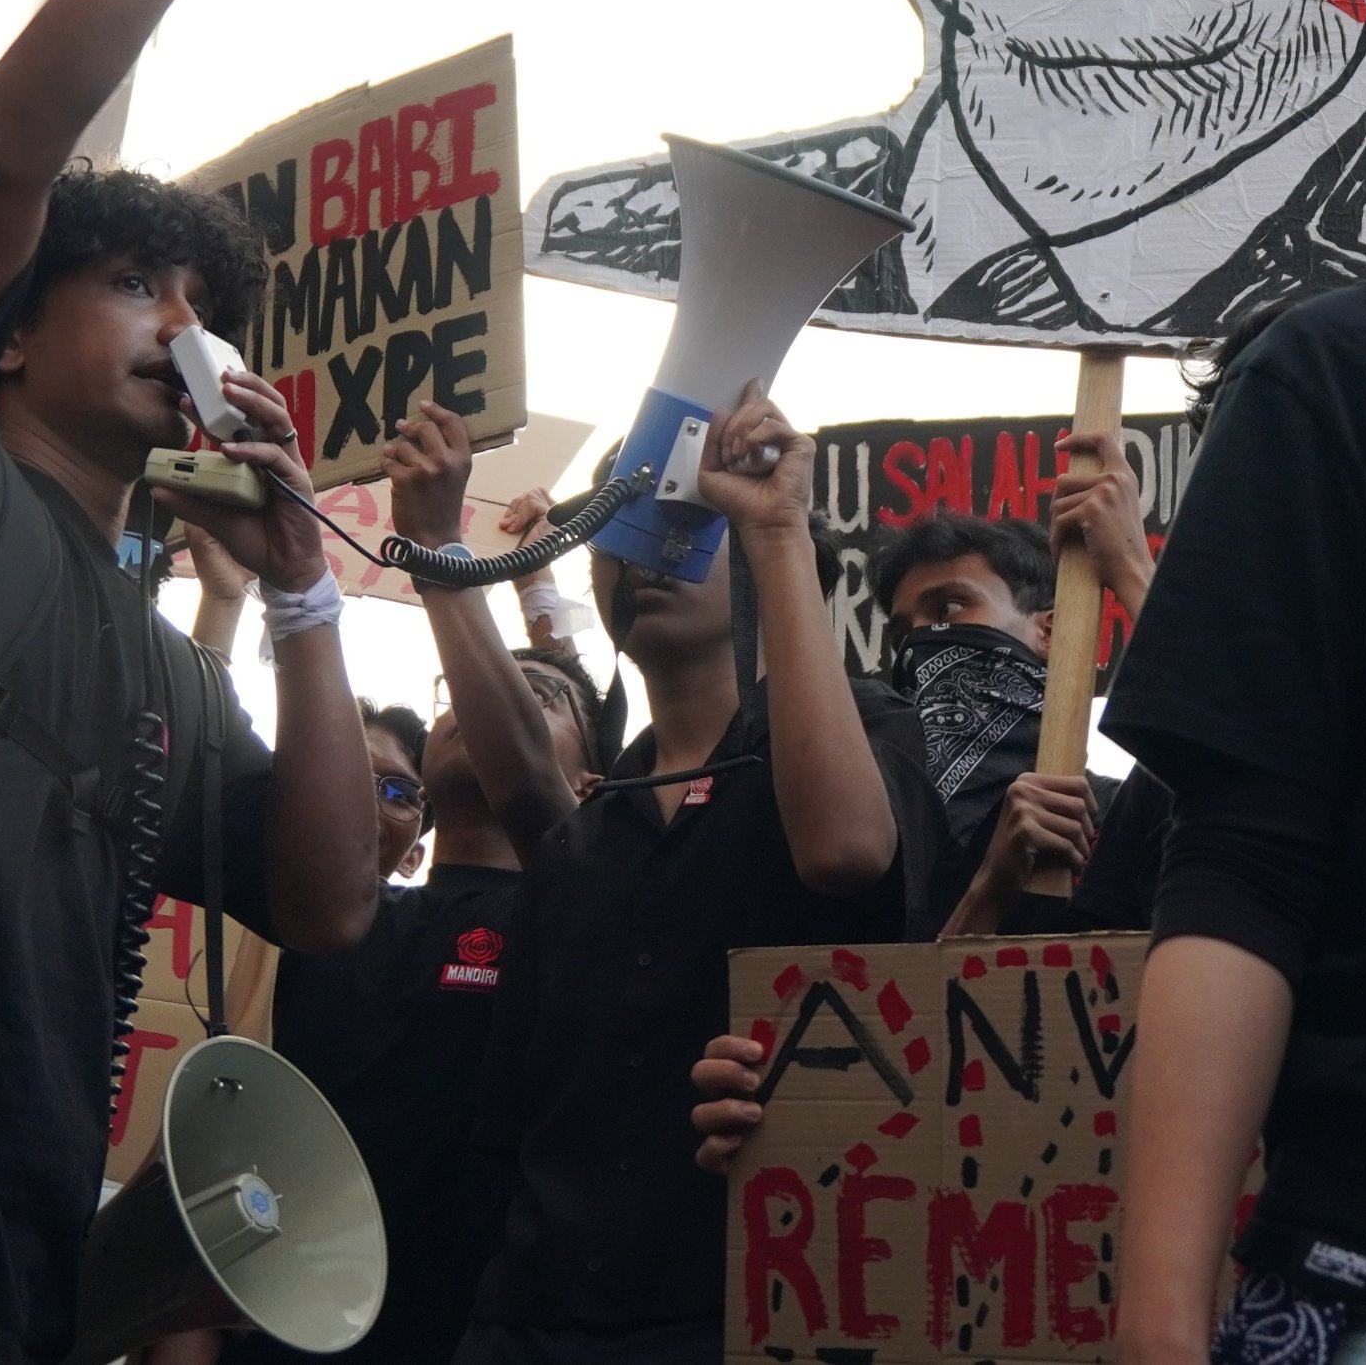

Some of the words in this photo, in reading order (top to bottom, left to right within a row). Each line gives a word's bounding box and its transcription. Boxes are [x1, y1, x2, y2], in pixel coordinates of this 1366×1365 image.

[309, 80, 502, 246] BABI
[272, 195, 492, 369] MAKAN
[322, 311, 489, 461] XPE
[446, 965, 499, 985] MANDIRI
[742, 1163, 1122, 1350] REME
